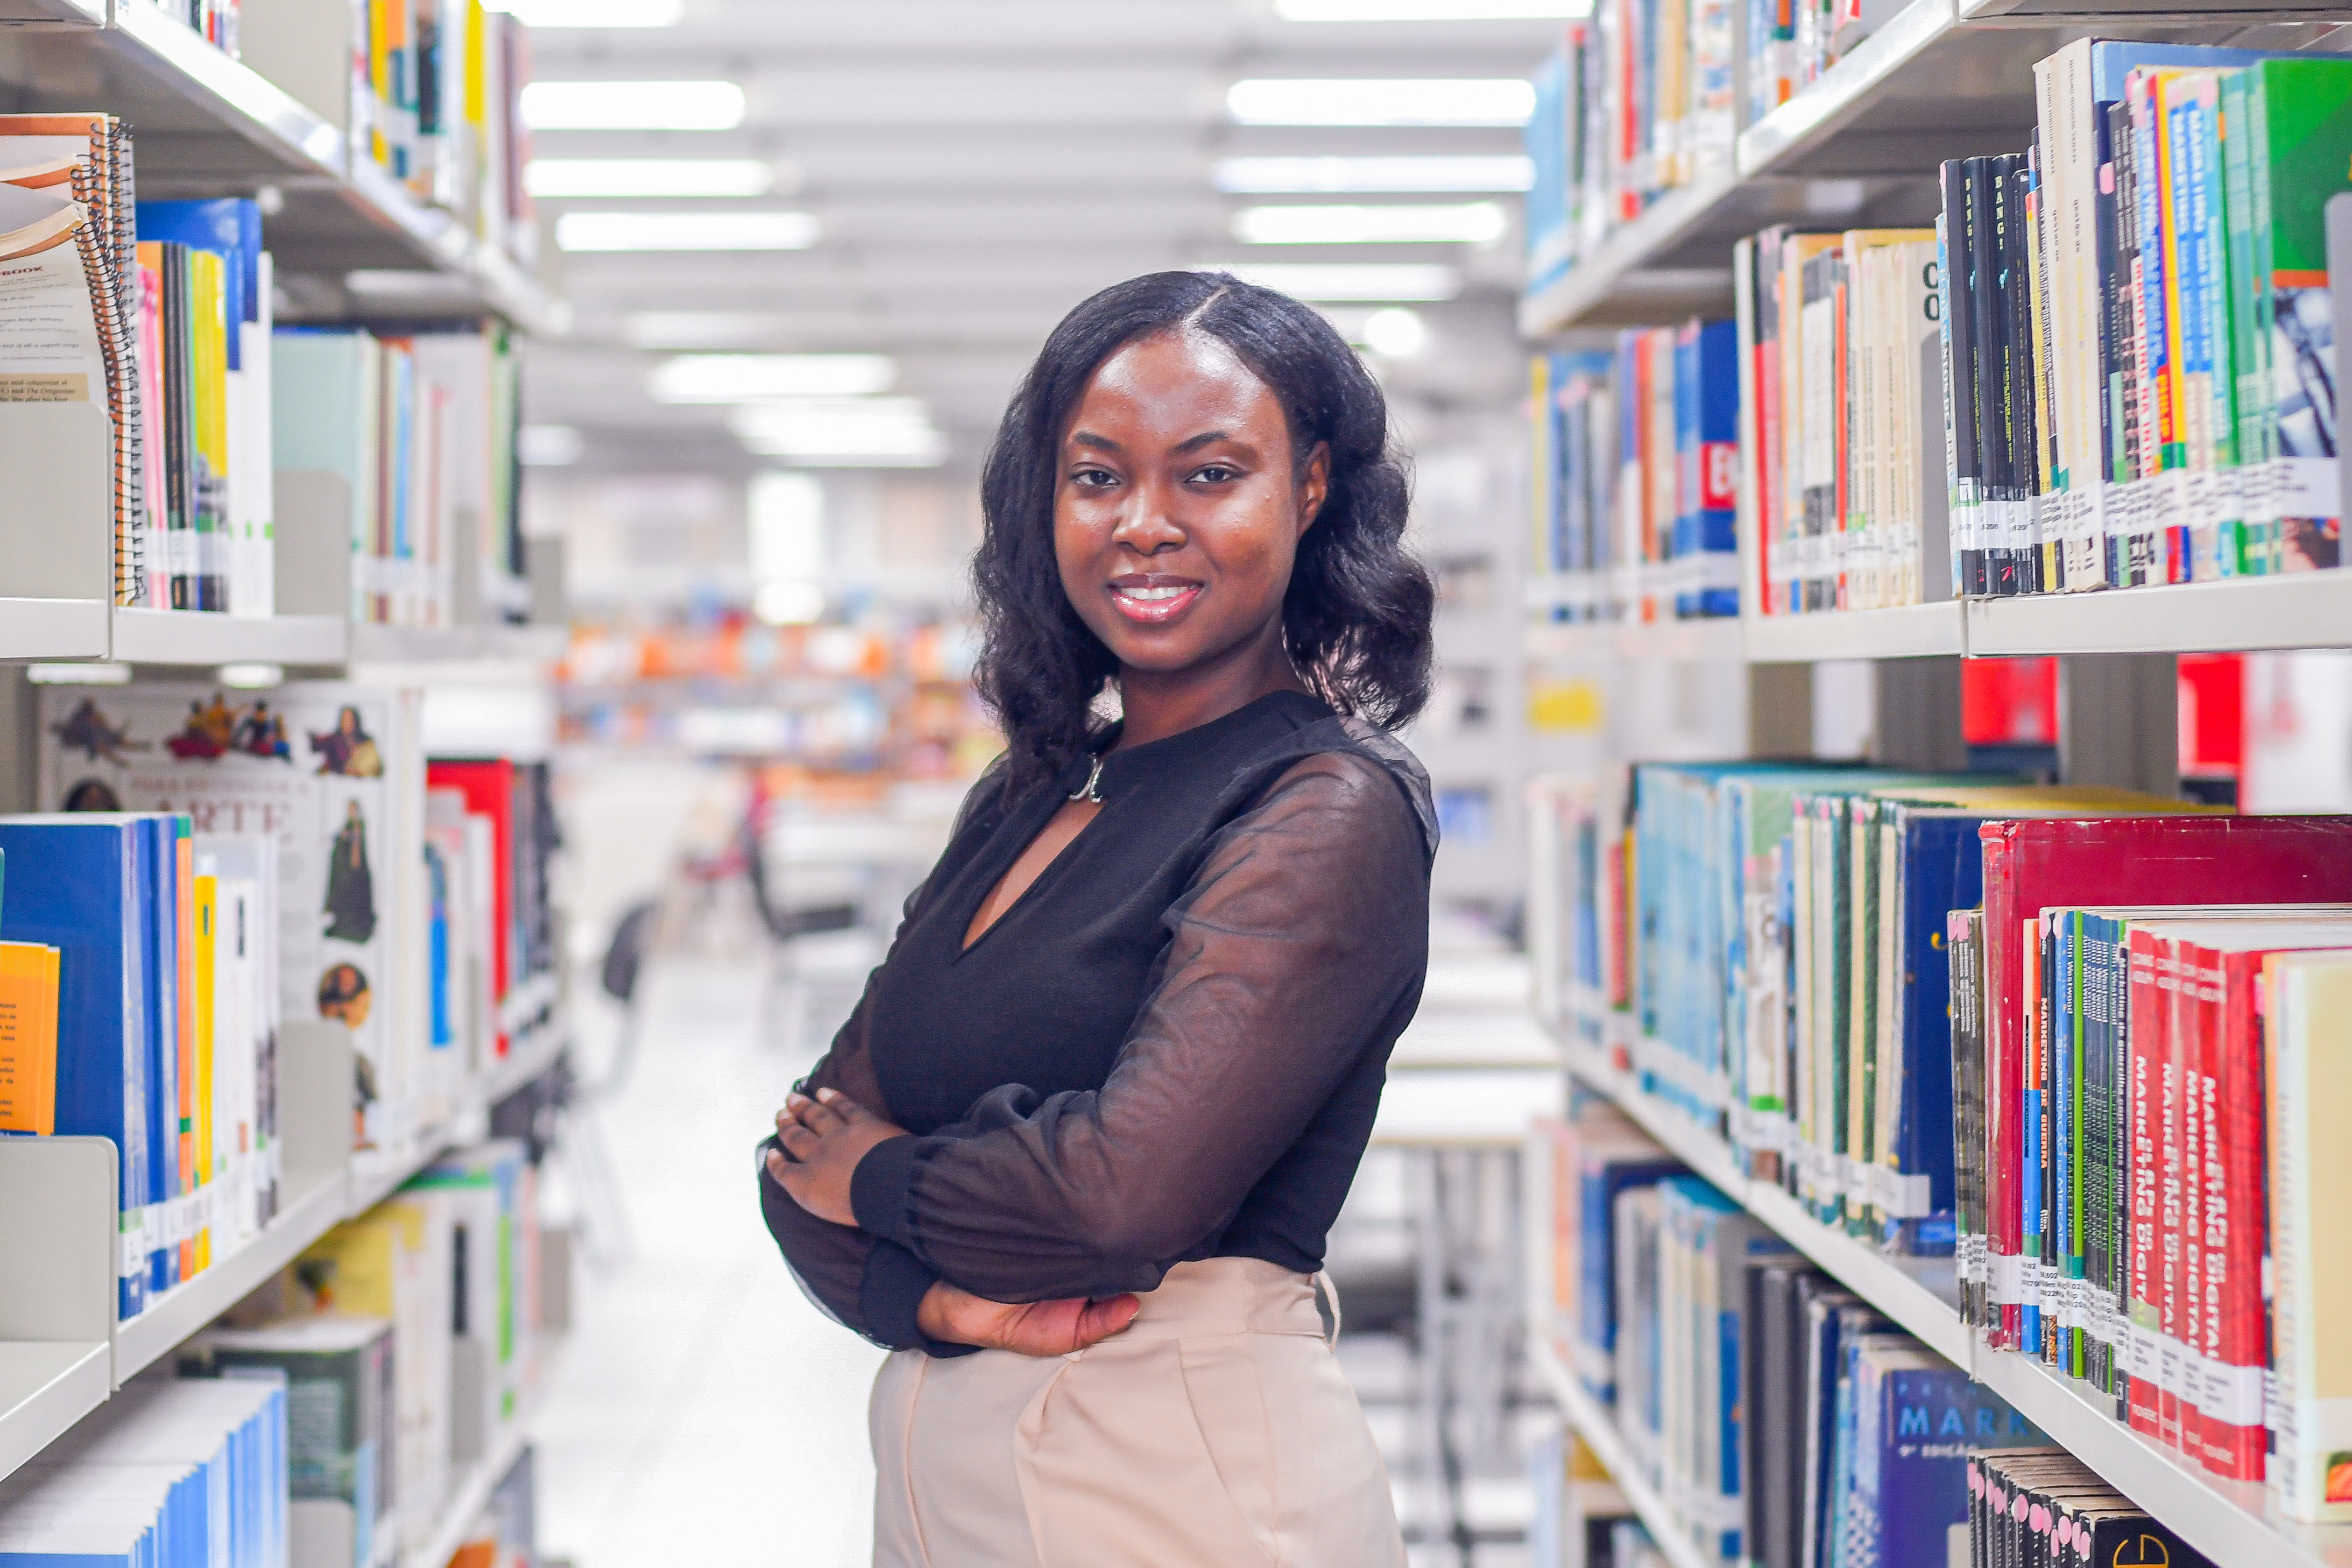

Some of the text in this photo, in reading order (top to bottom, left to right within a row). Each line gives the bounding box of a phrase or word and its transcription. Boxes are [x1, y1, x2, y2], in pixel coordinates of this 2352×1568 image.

[0, 266, 43, 275] BOOK
[1994, 175, 2005, 250] BANG!
[2041, 1088, 2048, 1107] DE
[2135, 1055, 2147, 1323] MARKETING DIGITAL
[2162, 1063, 2175, 1335] MARKETING DIGITAL
[2187, 1070, 2199, 1347] MARKETING DIGITAL
[2202, 1077, 2220, 1359] MARKETING DIGITAL
[1898, 1406, 2047, 1438] MARK
